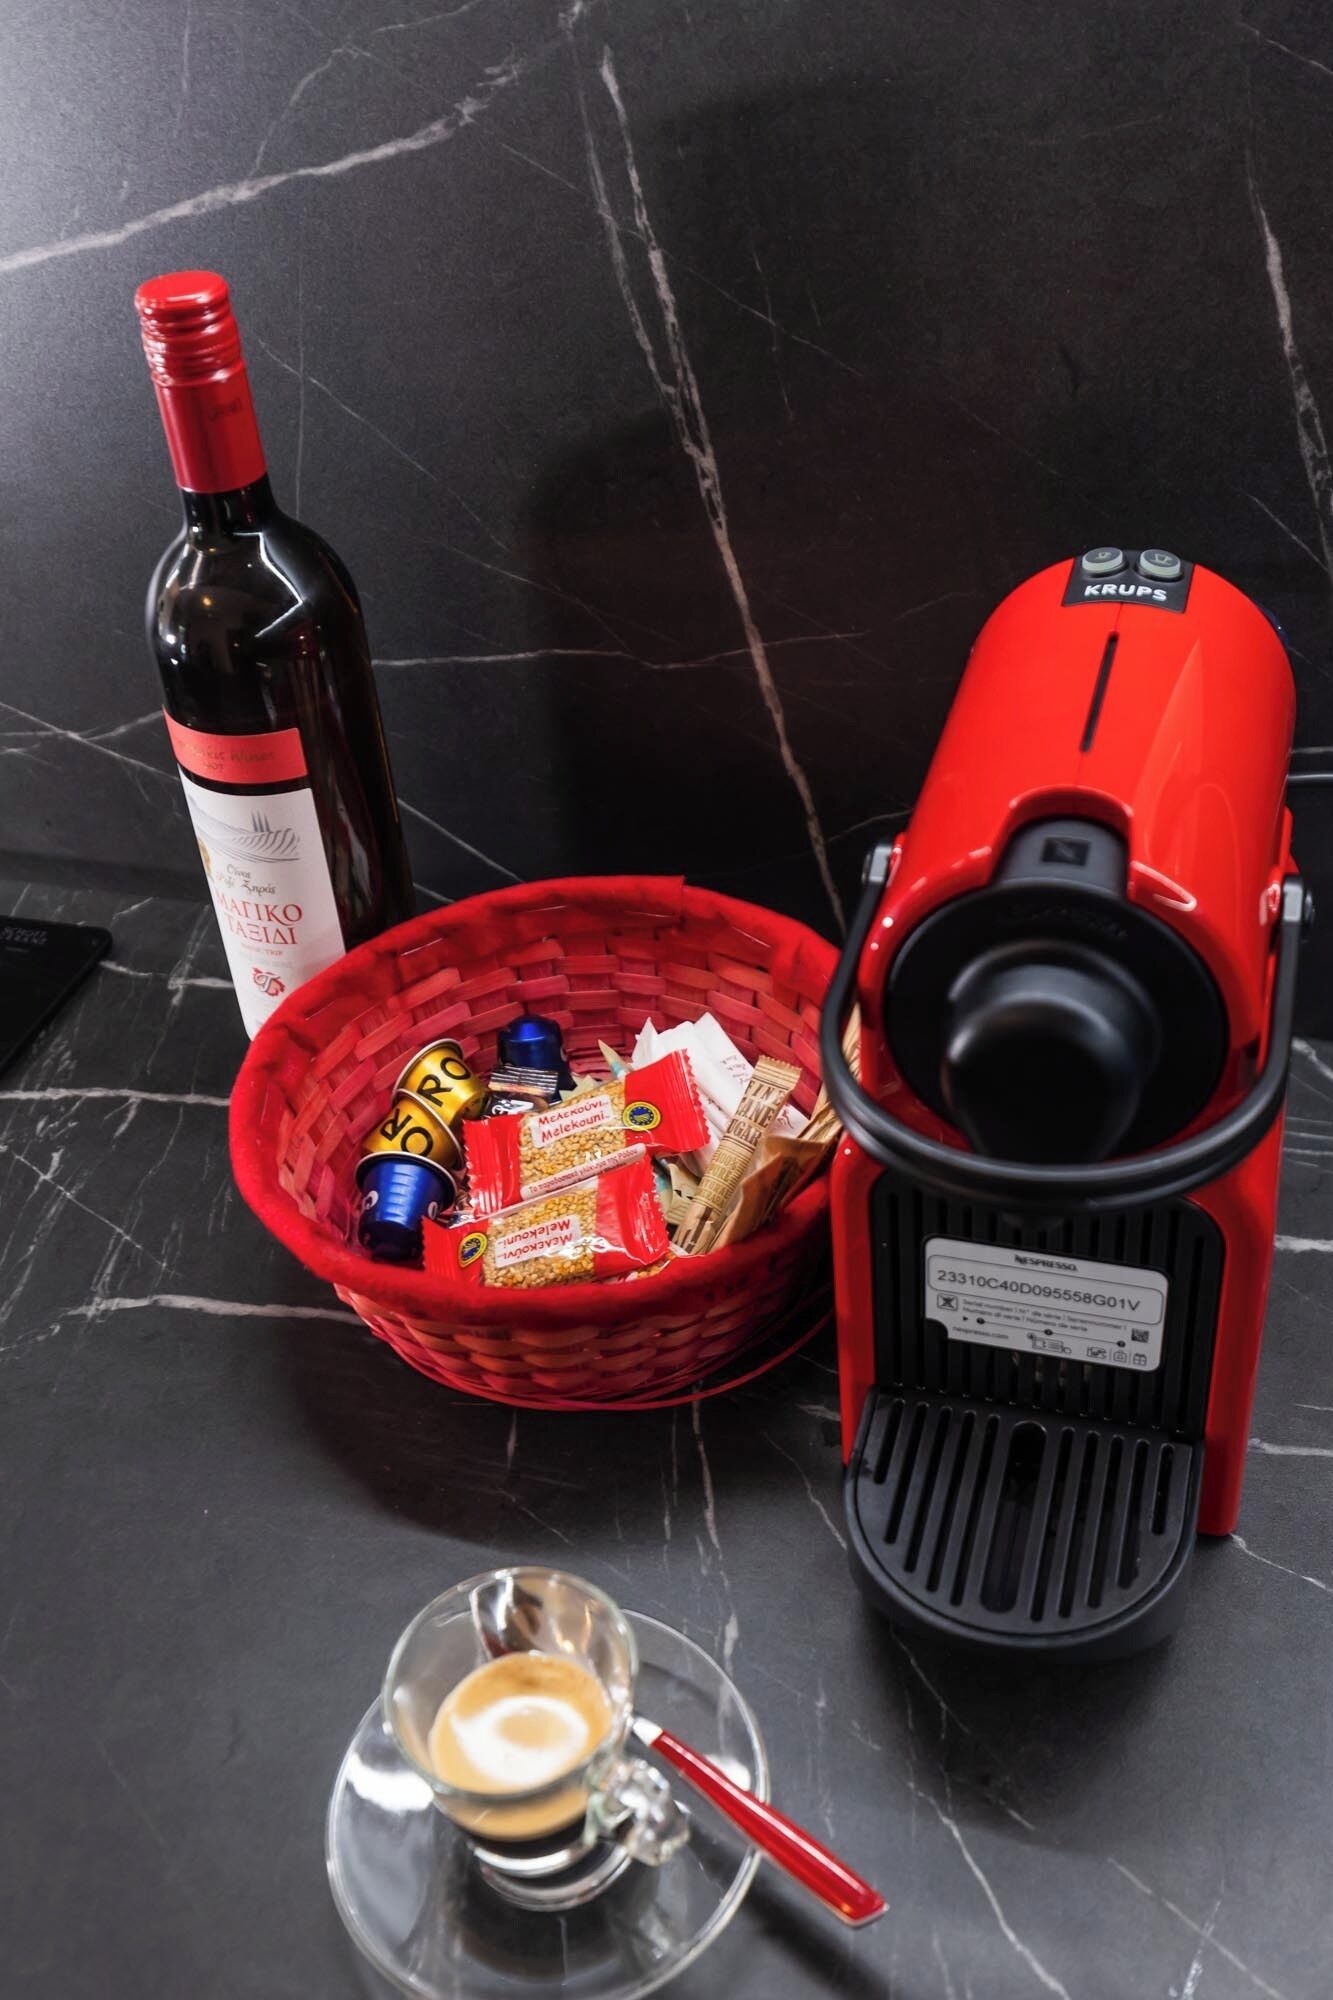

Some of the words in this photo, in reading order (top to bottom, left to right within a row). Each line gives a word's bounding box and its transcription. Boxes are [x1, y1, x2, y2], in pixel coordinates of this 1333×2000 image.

[1084, 583, 1167, 602] KRUPS
[727, 1119, 761, 1147] UGAR
[1014, 1254, 1078, 1272] NESPRESSO
[937, 1269, 1141, 1312] 23310C40D095558G01V
